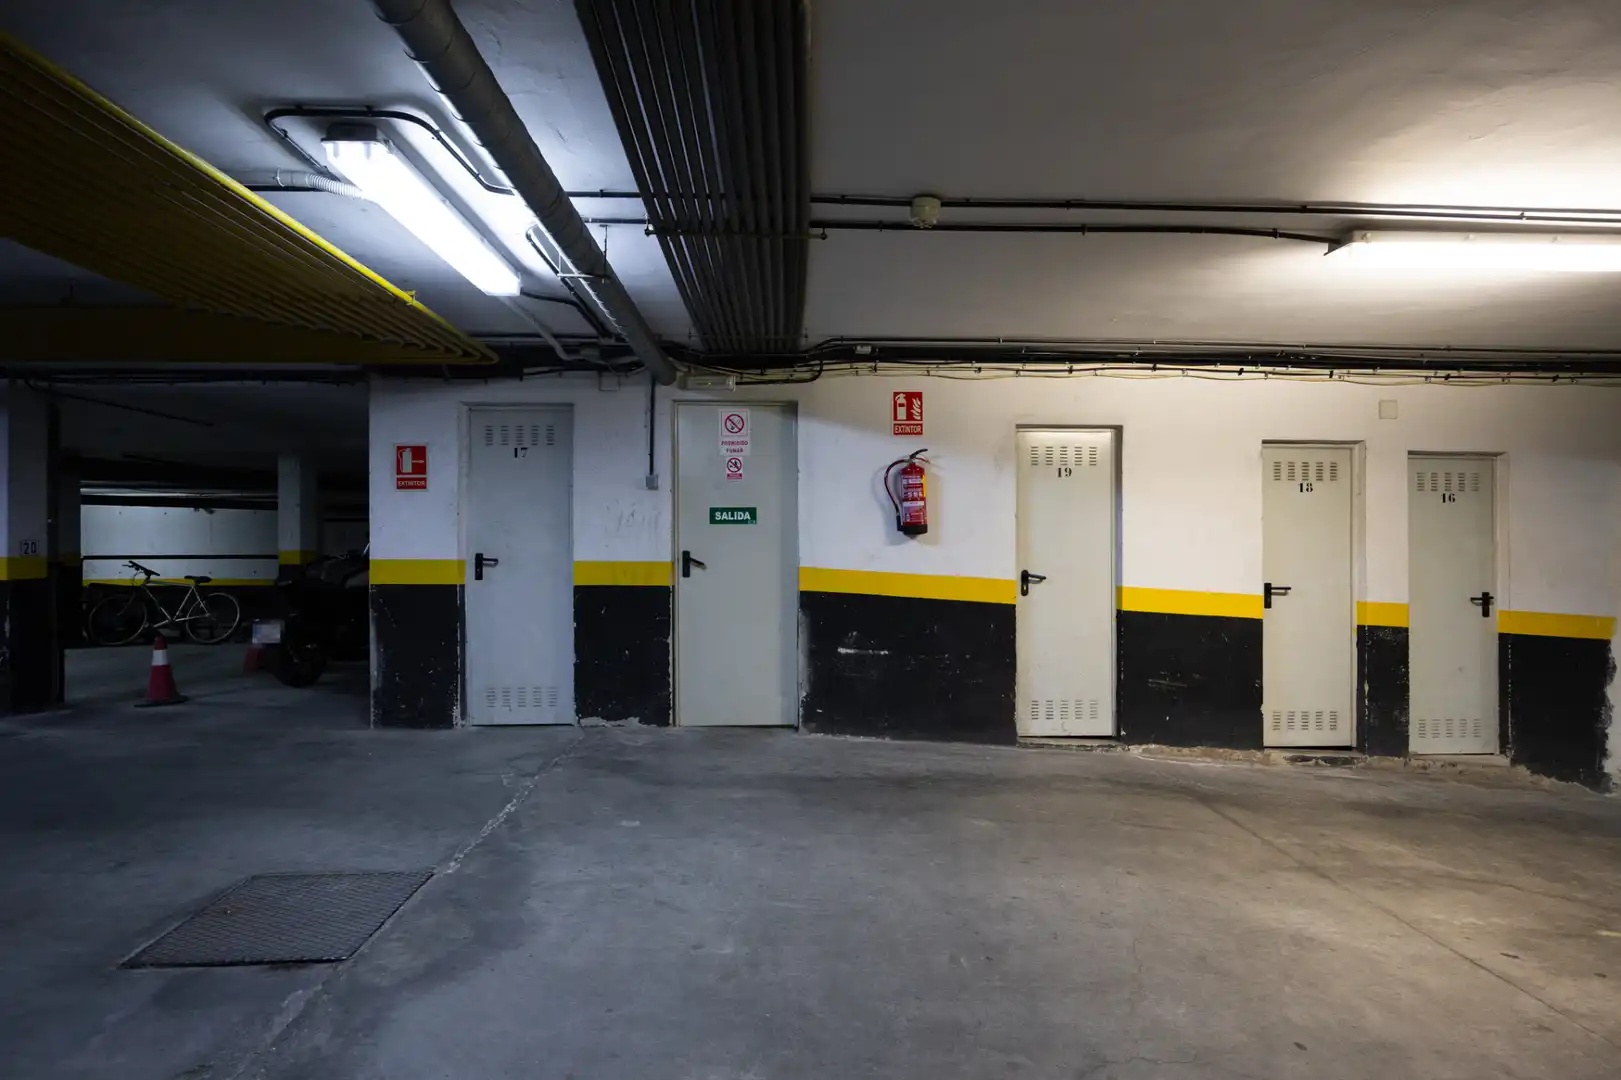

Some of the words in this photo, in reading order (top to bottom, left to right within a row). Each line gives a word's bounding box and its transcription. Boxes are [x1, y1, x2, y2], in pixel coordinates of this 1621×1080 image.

[895, 425, 921, 433] EXTINTOR
[513, 447, 528, 458] 17
[1057, 467, 1072, 478] 19
[1298, 482, 1313, 493] 18
[1441, 492, 1456, 503] 16
[715, 511, 751, 521] SALIDA
[23, 541, 37, 555] 20
